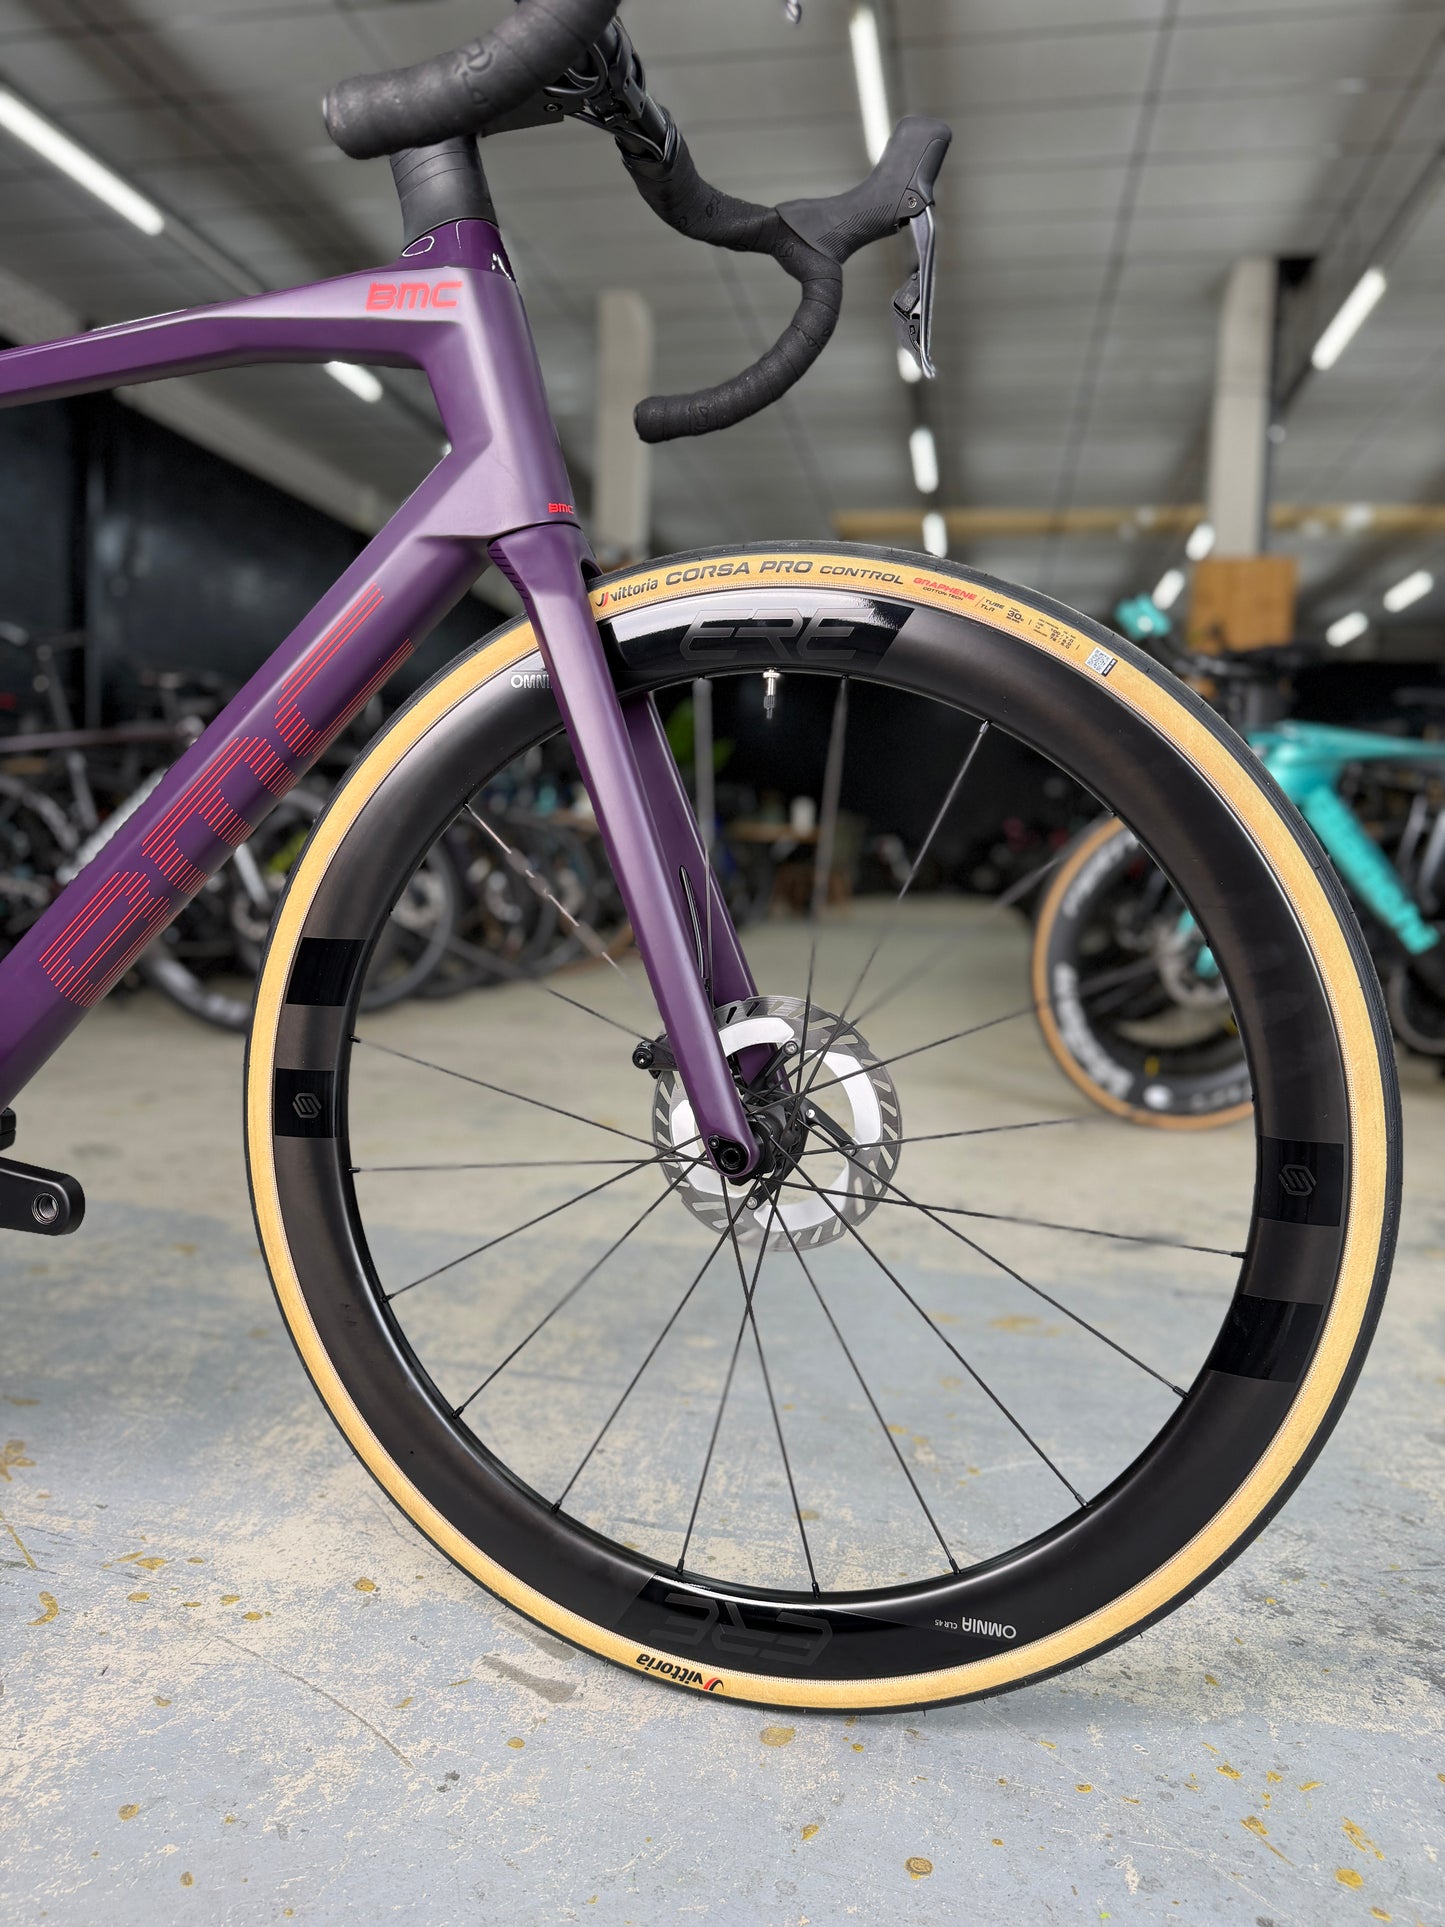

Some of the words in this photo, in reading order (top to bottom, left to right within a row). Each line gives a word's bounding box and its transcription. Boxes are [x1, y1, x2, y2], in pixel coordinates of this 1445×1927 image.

[365, 280, 463, 311] BMC
[548, 502, 574, 515] BMC
[610, 577, 658, 601] vittoria
[665, 561, 750, 586] CORSA
[759, 560, 813, 574] PRO
[819, 565, 905, 585] CONTROL
[913, 577, 978, 600] GRAPHENE
[985, 599, 1005, 610] TUBE
[510, 673, 552, 689] OMNI
[39, 583, 414, 1008] BMC
[934, 1619, 944, 1627] 45
[944, 1620, 958, 1630] CLR
[961, 1616, 1017, 1639] OMNIA
[636, 1653, 703, 1685] vittoria
